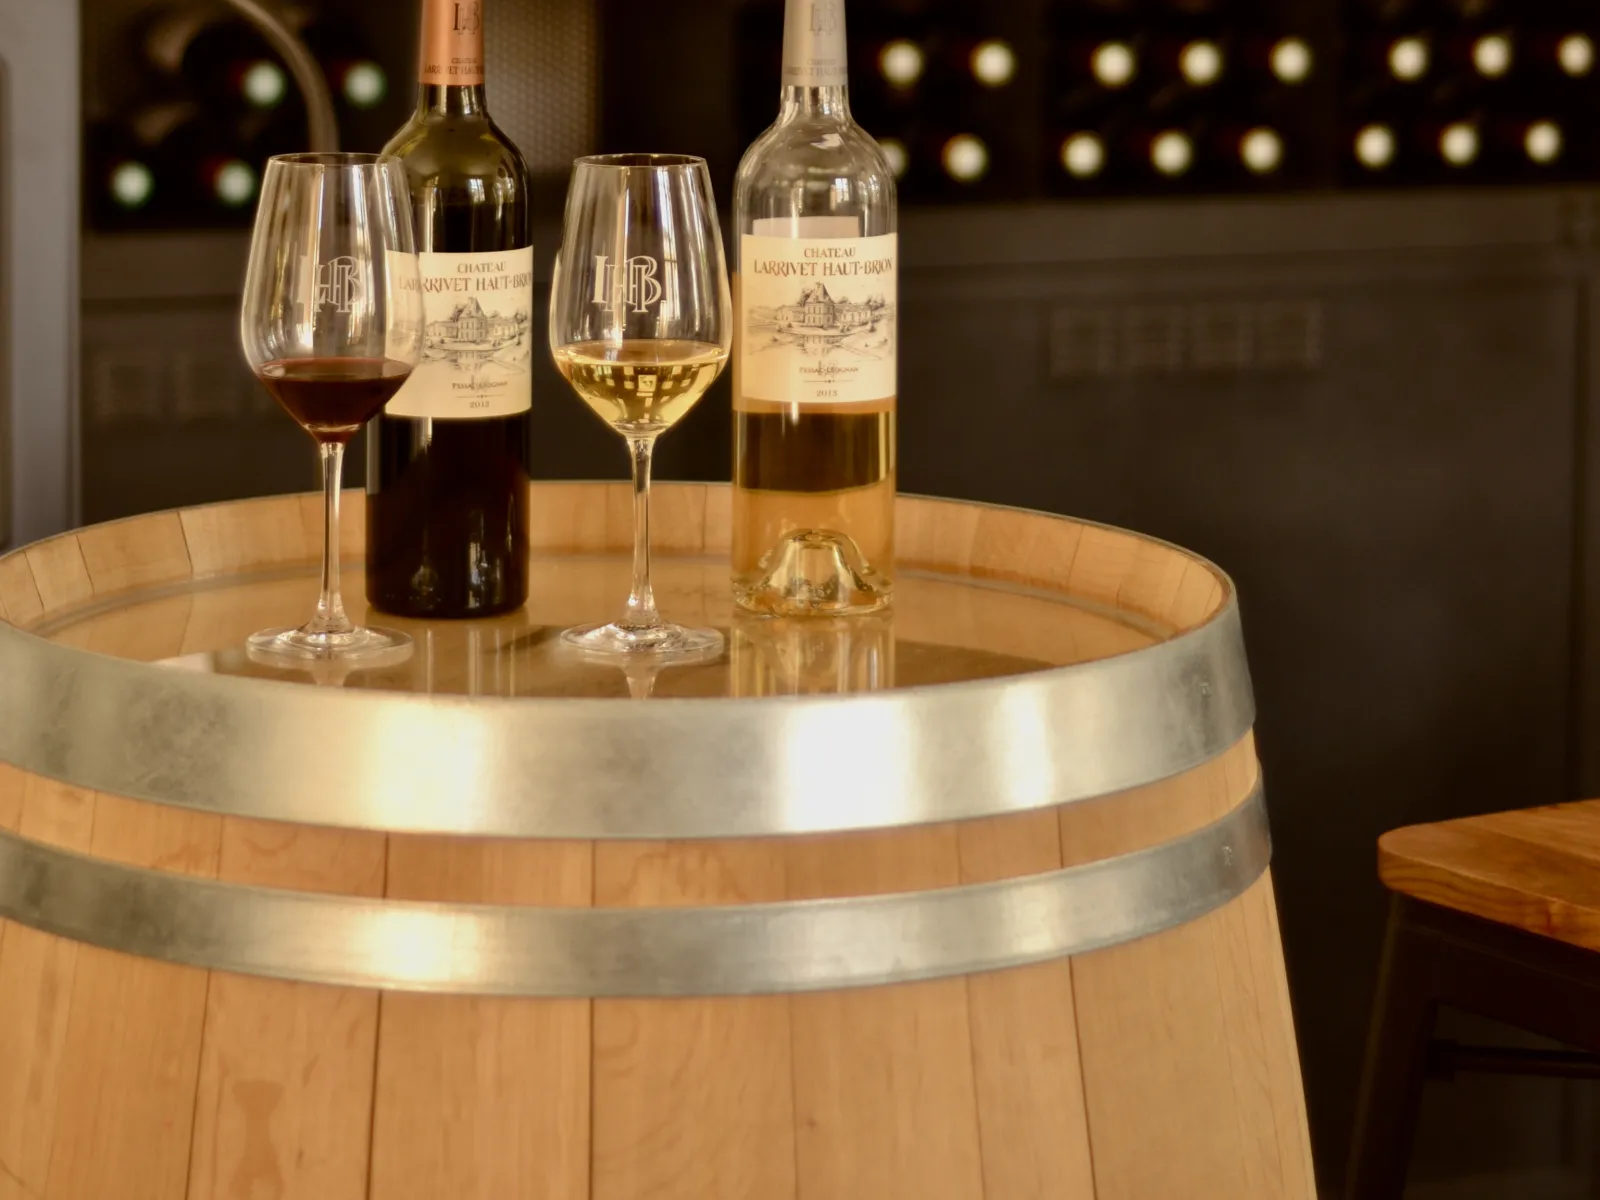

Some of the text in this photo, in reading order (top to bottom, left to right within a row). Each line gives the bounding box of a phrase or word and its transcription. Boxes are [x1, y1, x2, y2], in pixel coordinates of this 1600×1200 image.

[803, 246, 857, 259] CHATEAU
[457, 261, 507, 274] CHATEAU
[754, 257, 893, 277] LARRIVET HAUT-BRION
